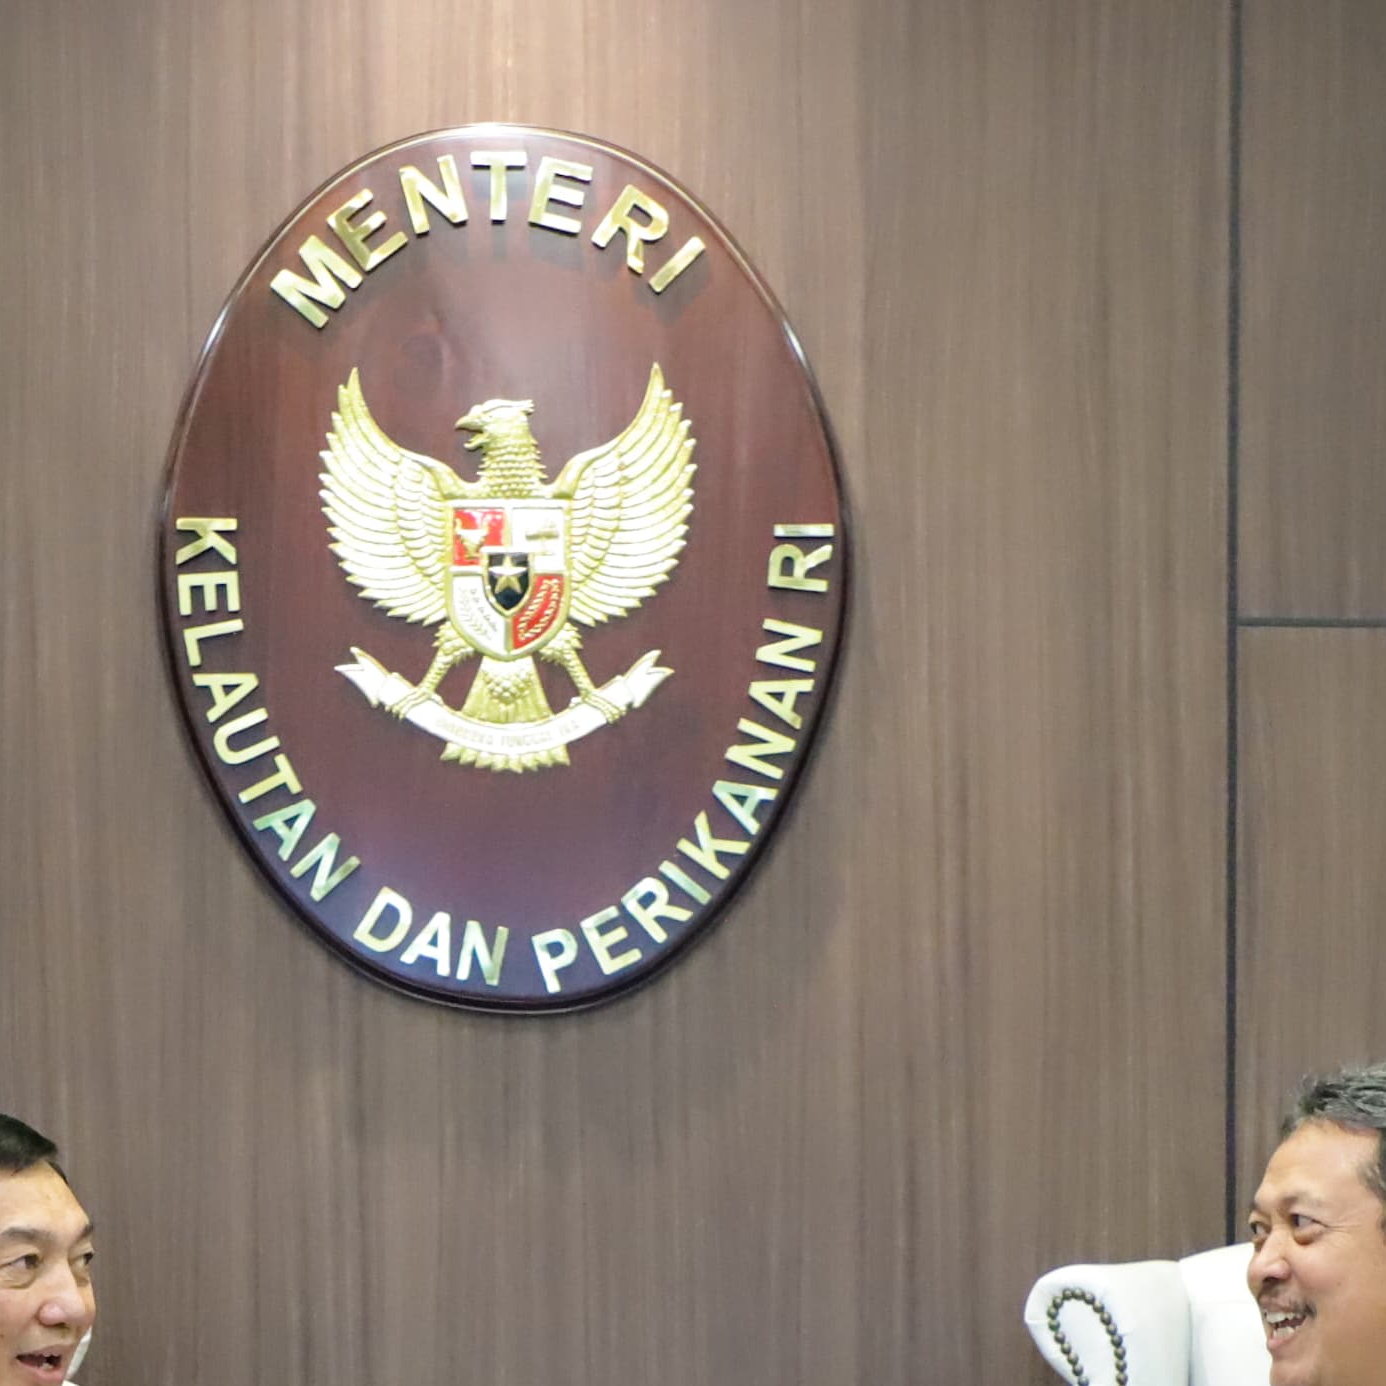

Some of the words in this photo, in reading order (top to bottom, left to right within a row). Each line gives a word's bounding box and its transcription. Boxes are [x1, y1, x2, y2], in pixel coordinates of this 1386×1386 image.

[270, 150, 705, 328] MENTERI
[176, 518, 360, 902] KELAUTAN
[353, 886, 508, 986] DAN
[531, 618, 823, 993] PERIKANAN
[768, 523, 835, 593] RI
